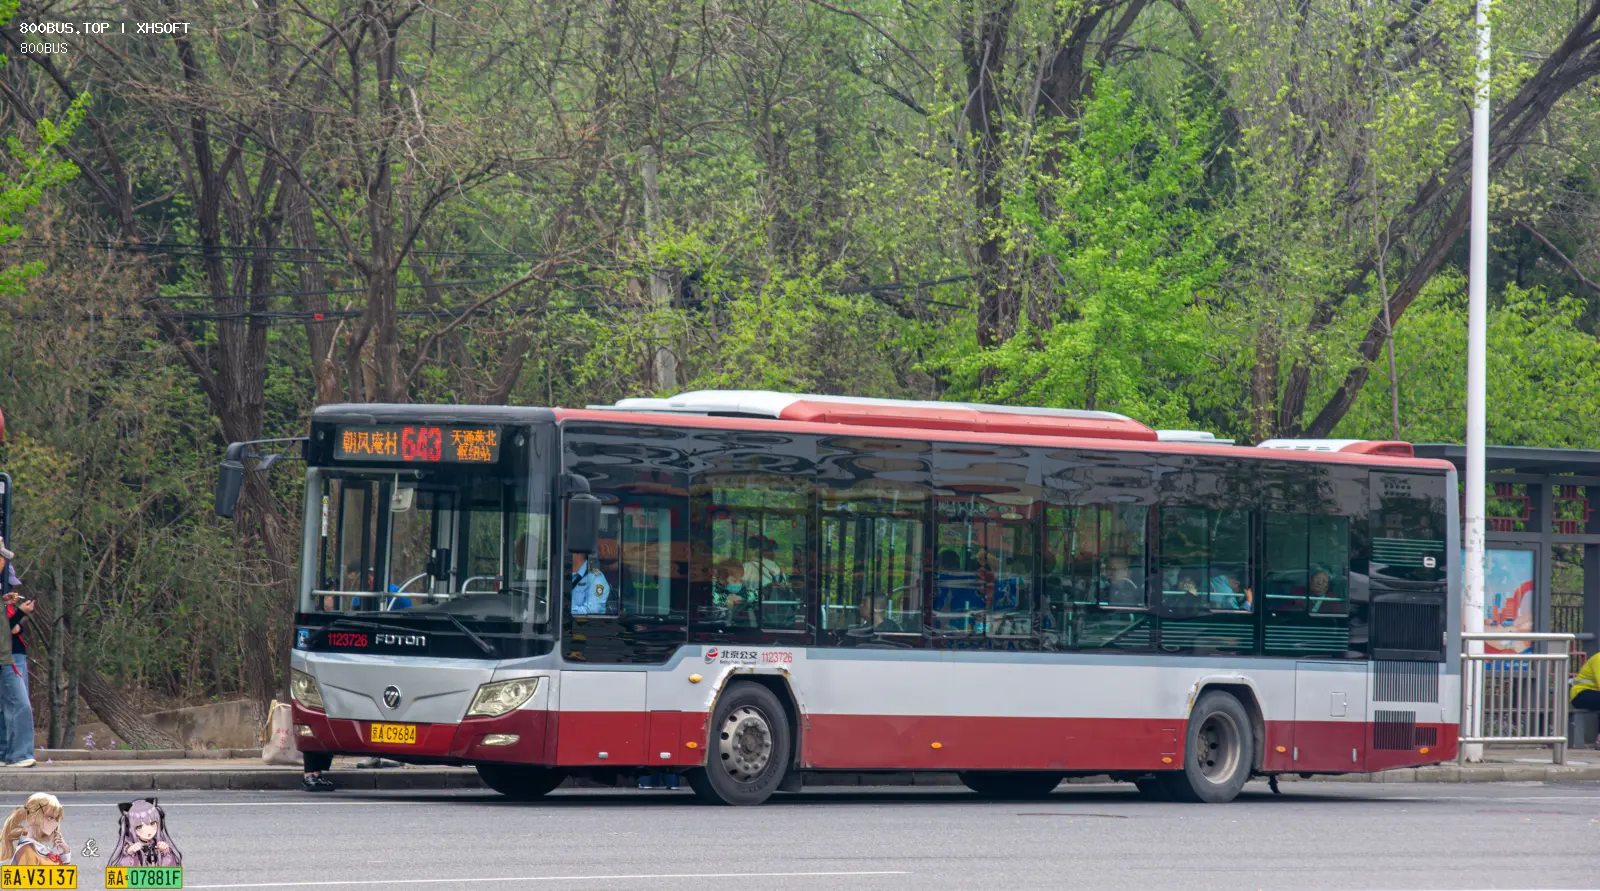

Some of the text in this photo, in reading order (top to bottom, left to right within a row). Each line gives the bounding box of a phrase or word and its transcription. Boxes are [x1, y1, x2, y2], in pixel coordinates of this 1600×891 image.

[401, 427, 442, 461] 643
[450, 429, 497, 446] 天通苑北
[328, 633, 368, 647] 1123726
[375, 633, 426, 647] FOTON
[720, 650, 758, 660] 北京公交
[761, 651, 793, 663] 1123726
